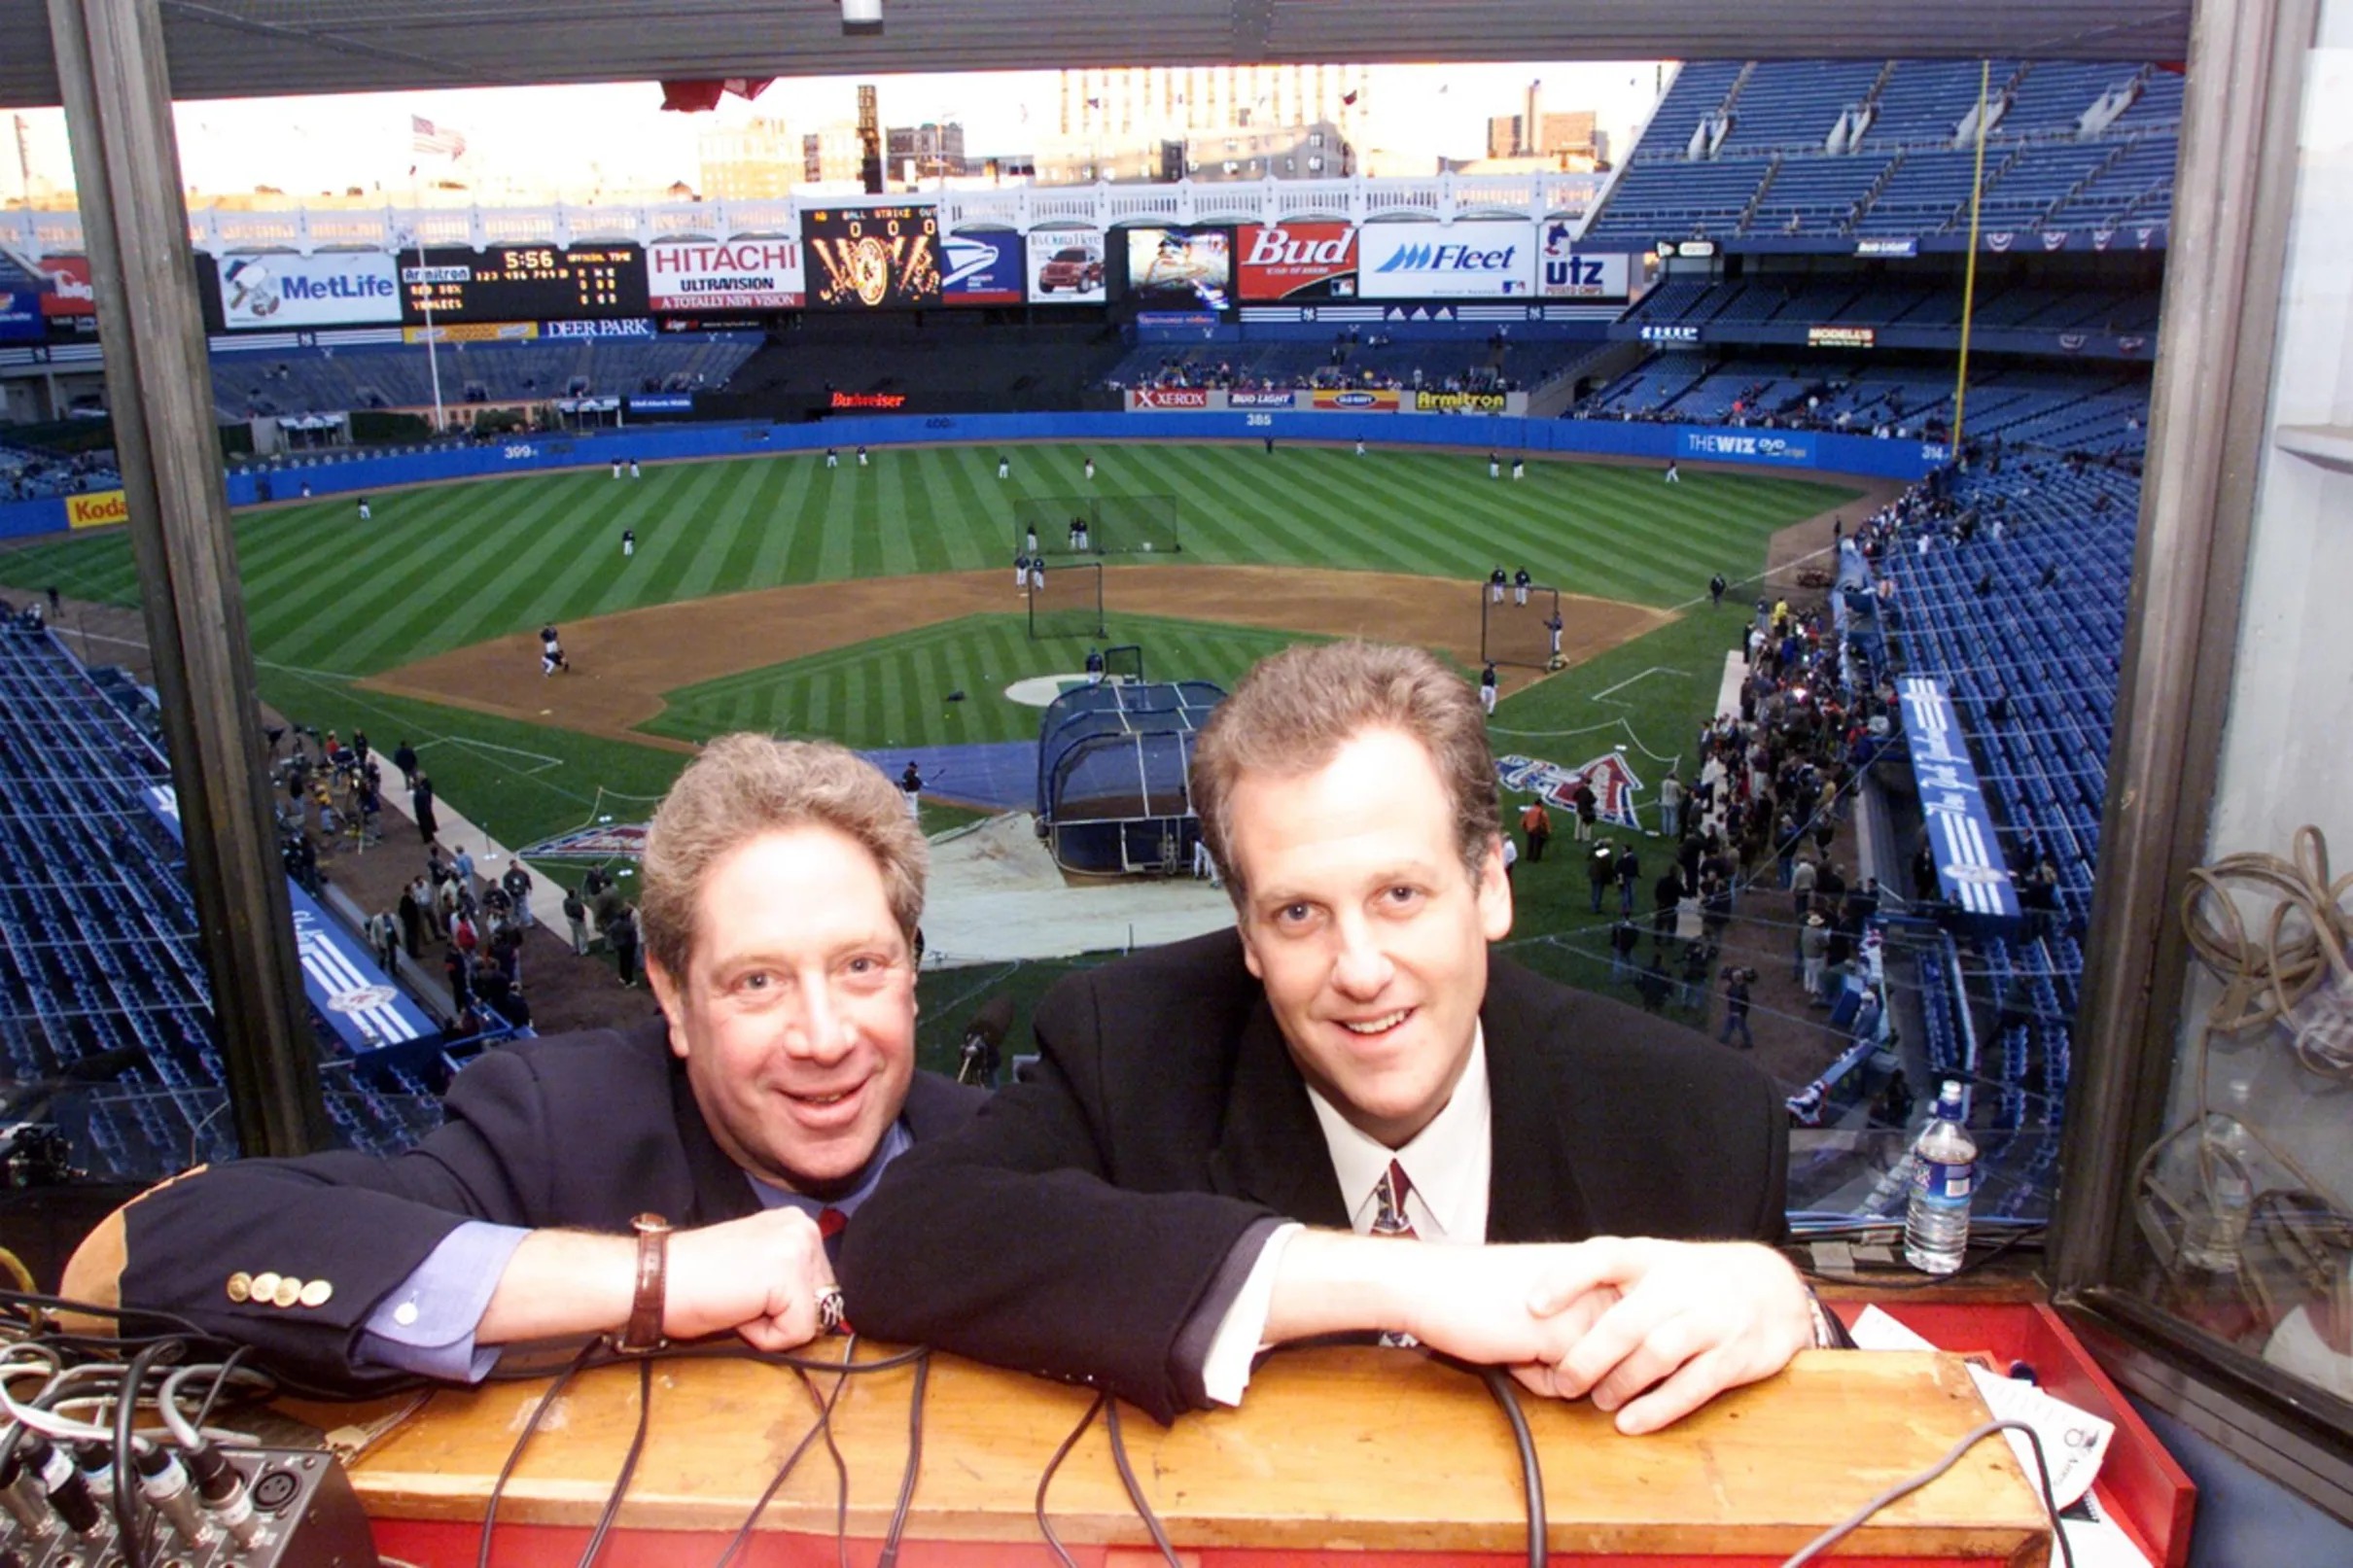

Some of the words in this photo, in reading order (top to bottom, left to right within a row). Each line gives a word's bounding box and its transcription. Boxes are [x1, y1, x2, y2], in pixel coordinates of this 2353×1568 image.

[850, 221, 861, 237] 0
[888, 220, 899, 235] 0
[923, 219, 935, 234] 0
[1240, 227, 1354, 265] Bud
[504, 250, 554, 270] 5:56
[654, 244, 796, 274] HITACHI
[1431, 244, 1516, 270] Fleet
[1545, 256, 1603, 285] utz
[281, 272, 394, 300] MetLife
[680, 277, 775, 293] ULTRAVISION
[673, 296, 724, 308] TOTALLY
[725, 295, 753, 307] NEW
[754, 294, 795, 307] VISION
[547, 319, 598, 337] DEER
[600, 317, 649, 335] PARK
[830, 392, 905, 408] Budweiser
[1156, 393, 1206, 405] XEROX
[1232, 394, 1255, 404] BUD
[1257, 393, 1290, 404] LIGHT
[1417, 391, 1505, 409] Armitron
[504, 444, 531, 460] 399
[1716, 436, 1756, 455] WIZ
